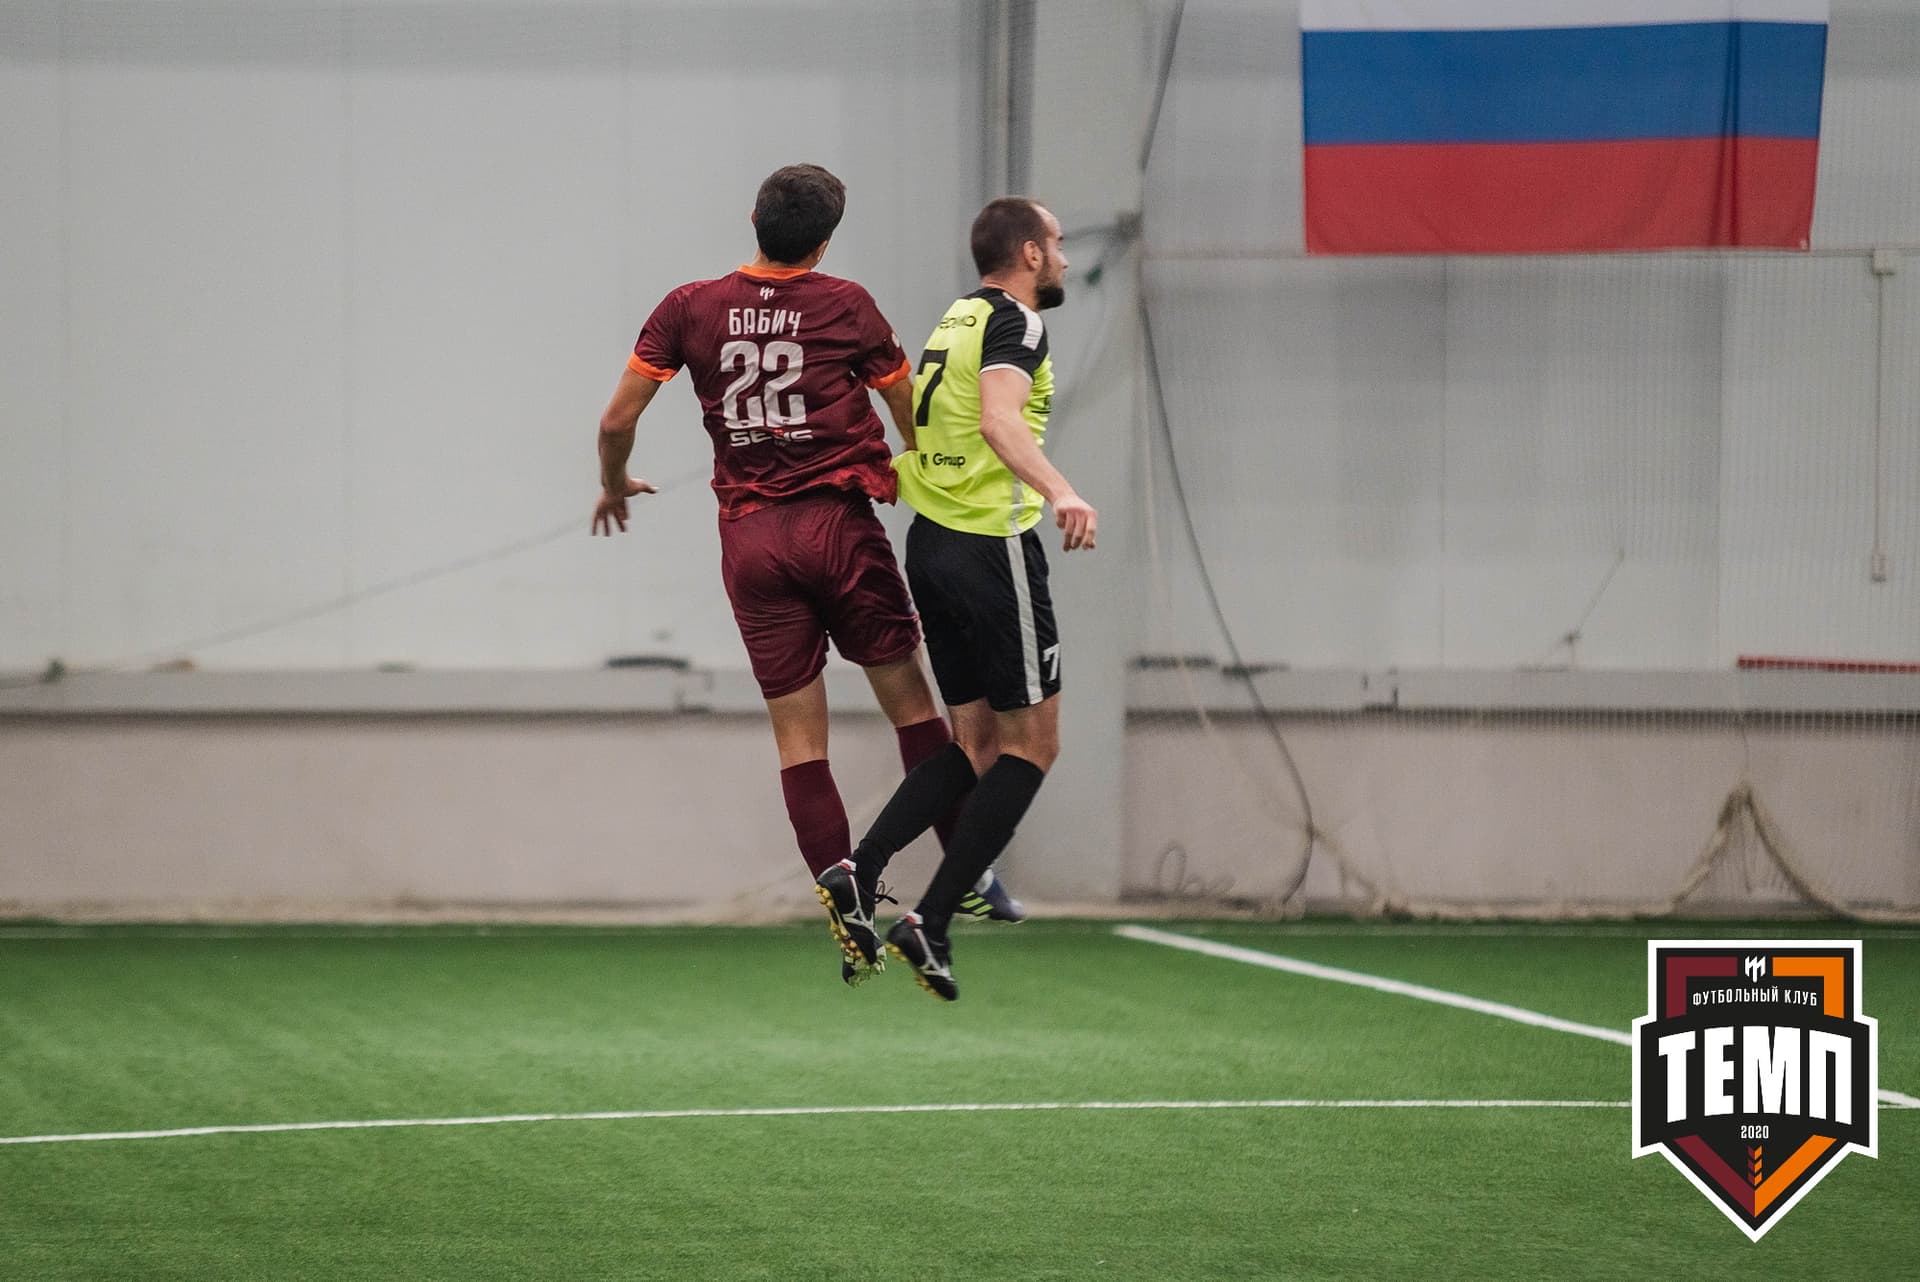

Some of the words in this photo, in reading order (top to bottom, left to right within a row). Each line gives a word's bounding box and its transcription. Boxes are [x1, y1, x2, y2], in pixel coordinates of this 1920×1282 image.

[729, 308, 801, 336] БАБИЧ
[720, 340, 805, 429] 22
[916, 349, 949, 426] 7
[1043, 643, 1060, 681] 7
